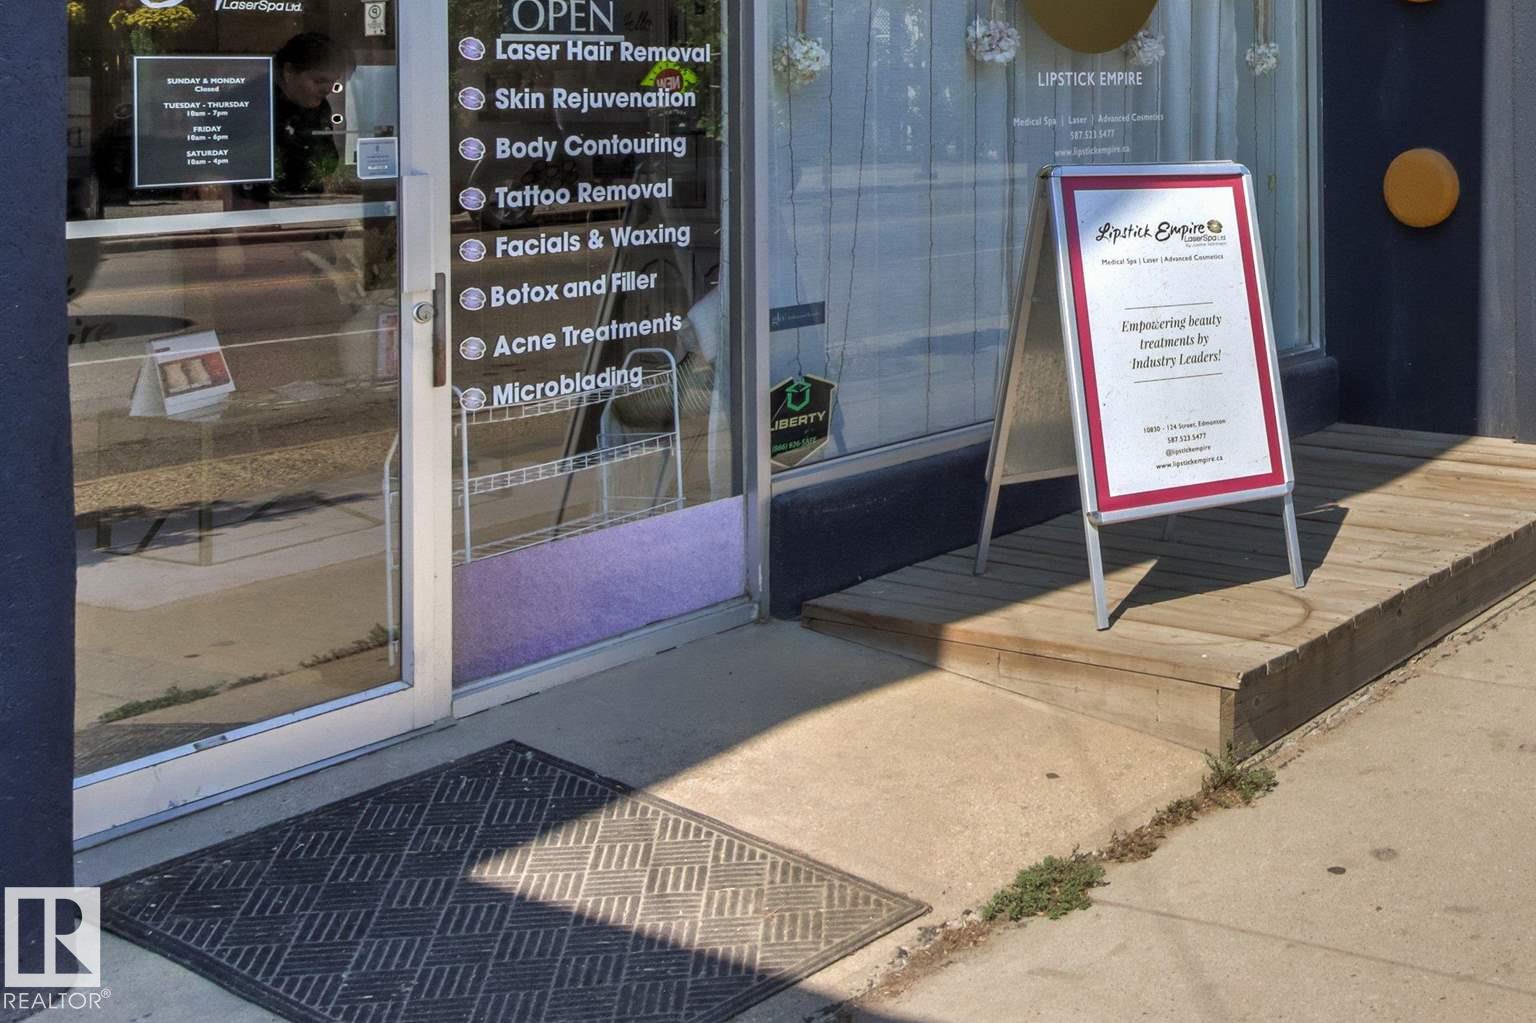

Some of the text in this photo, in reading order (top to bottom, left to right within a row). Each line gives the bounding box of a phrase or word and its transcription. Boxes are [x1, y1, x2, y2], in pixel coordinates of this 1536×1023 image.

[222, 0, 285, 13] LaserSpa
[496, 38, 711, 63] Laser Hair Removal
[1038, 71, 1143, 87] LIPSTICK EMPIRE
[496, 88, 544, 109] Skin
[553, 88, 696, 113] Rejuvenation
[1013, 112, 1164, 127] Medical Spa Laser Advanced Cosmetics
[496, 134, 687, 161] Body Contouring
[495, 178, 673, 208] Tattoo Removal
[496, 224, 690, 257] Facials & Waxing
[1095, 221, 1205, 245] Lipstick Empire
[1126, 257, 1137, 266] Spa
[1143, 256, 1159, 264] Laser
[1164, 255, 1193, 263] Advanced
[1194, 253, 1224, 261] Cosmetics
[491, 272, 657, 307] Botox and Filler
[1121, 314, 1222, 334] Empowering beauty
[493, 313, 682, 357] Acne Treatments
[1140, 333, 1209, 350] treatments by
[1132, 349, 1222, 370] Industry Leaders!
[493, 367, 642, 405] Microblading
[1143, 425, 1161, 434] 10830
[1166, 423, 1177, 431] 124
[1198, 418, 1226, 427] Edmonton
[1167, 432, 1207, 444] 587.523.5477
[1165, 444, 1211, 456] @lipstickempire
[1156, 455, 1223, 470] www.lipstickempire.ca
